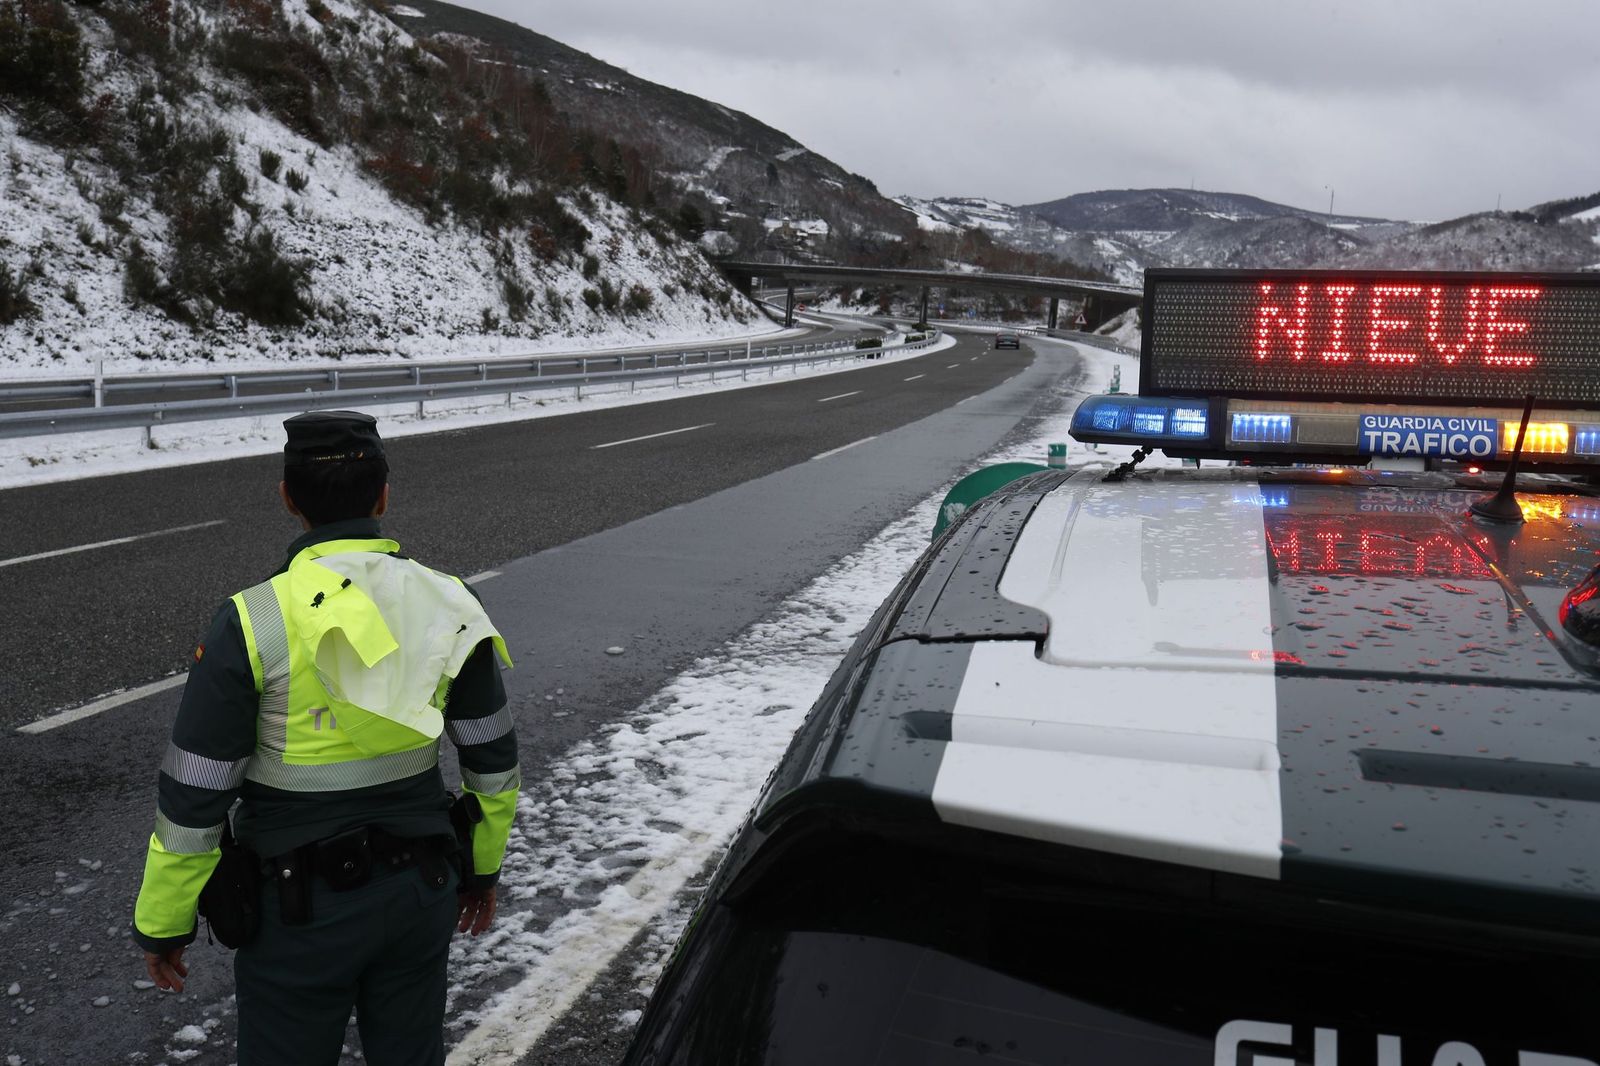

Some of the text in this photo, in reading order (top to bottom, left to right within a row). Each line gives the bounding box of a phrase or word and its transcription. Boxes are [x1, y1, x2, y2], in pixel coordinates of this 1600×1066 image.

[1257, 283, 1539, 366] NIEVE
[1364, 415, 1494, 432] GUARDIA CIVIL
[1364, 430, 1492, 457] TRAFICO
